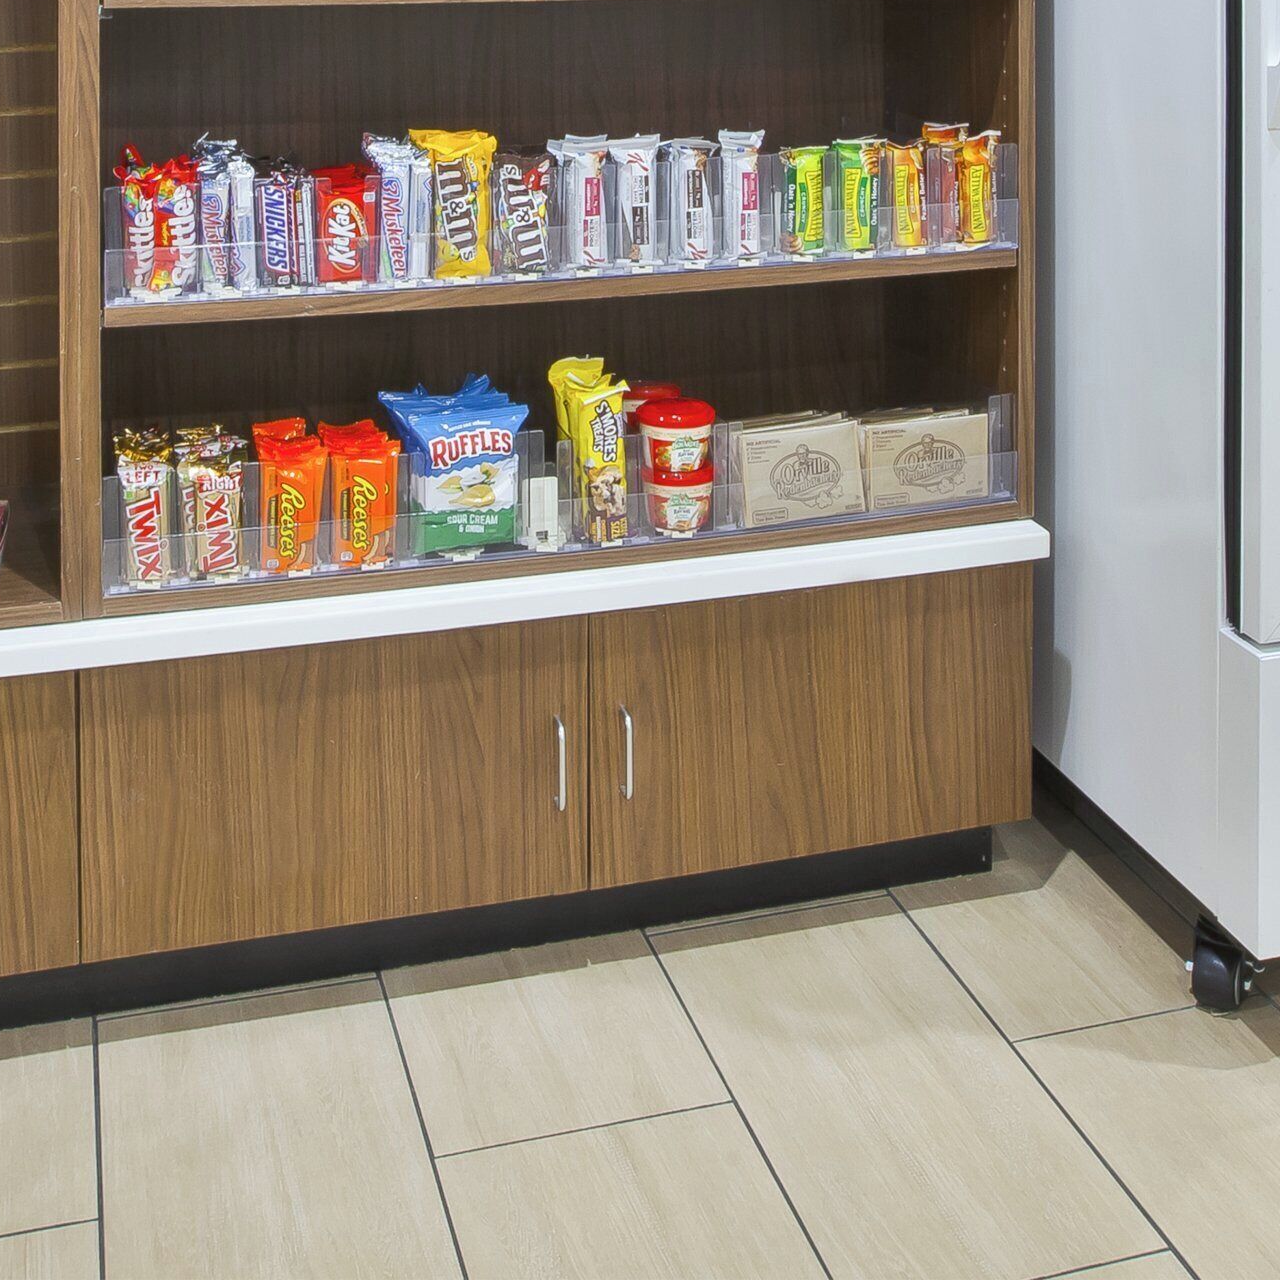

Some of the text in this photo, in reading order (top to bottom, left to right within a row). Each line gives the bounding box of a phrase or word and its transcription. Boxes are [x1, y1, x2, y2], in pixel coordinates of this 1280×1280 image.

[787, 184, 796, 200] Oats
[870, 177, 879, 200] Honey
[896, 167, 908, 199] VALLEY
[845, 169, 859, 236] NATURE VALLEY
[972, 166, 984, 230] NATURE VALLEY
[264, 187, 287, 270] SNICKERS
[786, 210, 796, 232] Honey
[870, 208, 878, 225] Oats
[168, 185, 196, 287] Skittles
[590, 418, 603, 453] TREATS
[596, 401, 616, 462] S'MORES
[431, 431, 512, 468] RUFFLES
[905, 448, 954, 470] Orville
[125, 470, 160, 483] LEFT
[783, 459, 830, 485] Orville
[447, 514, 498, 525] SOUR CREAM
